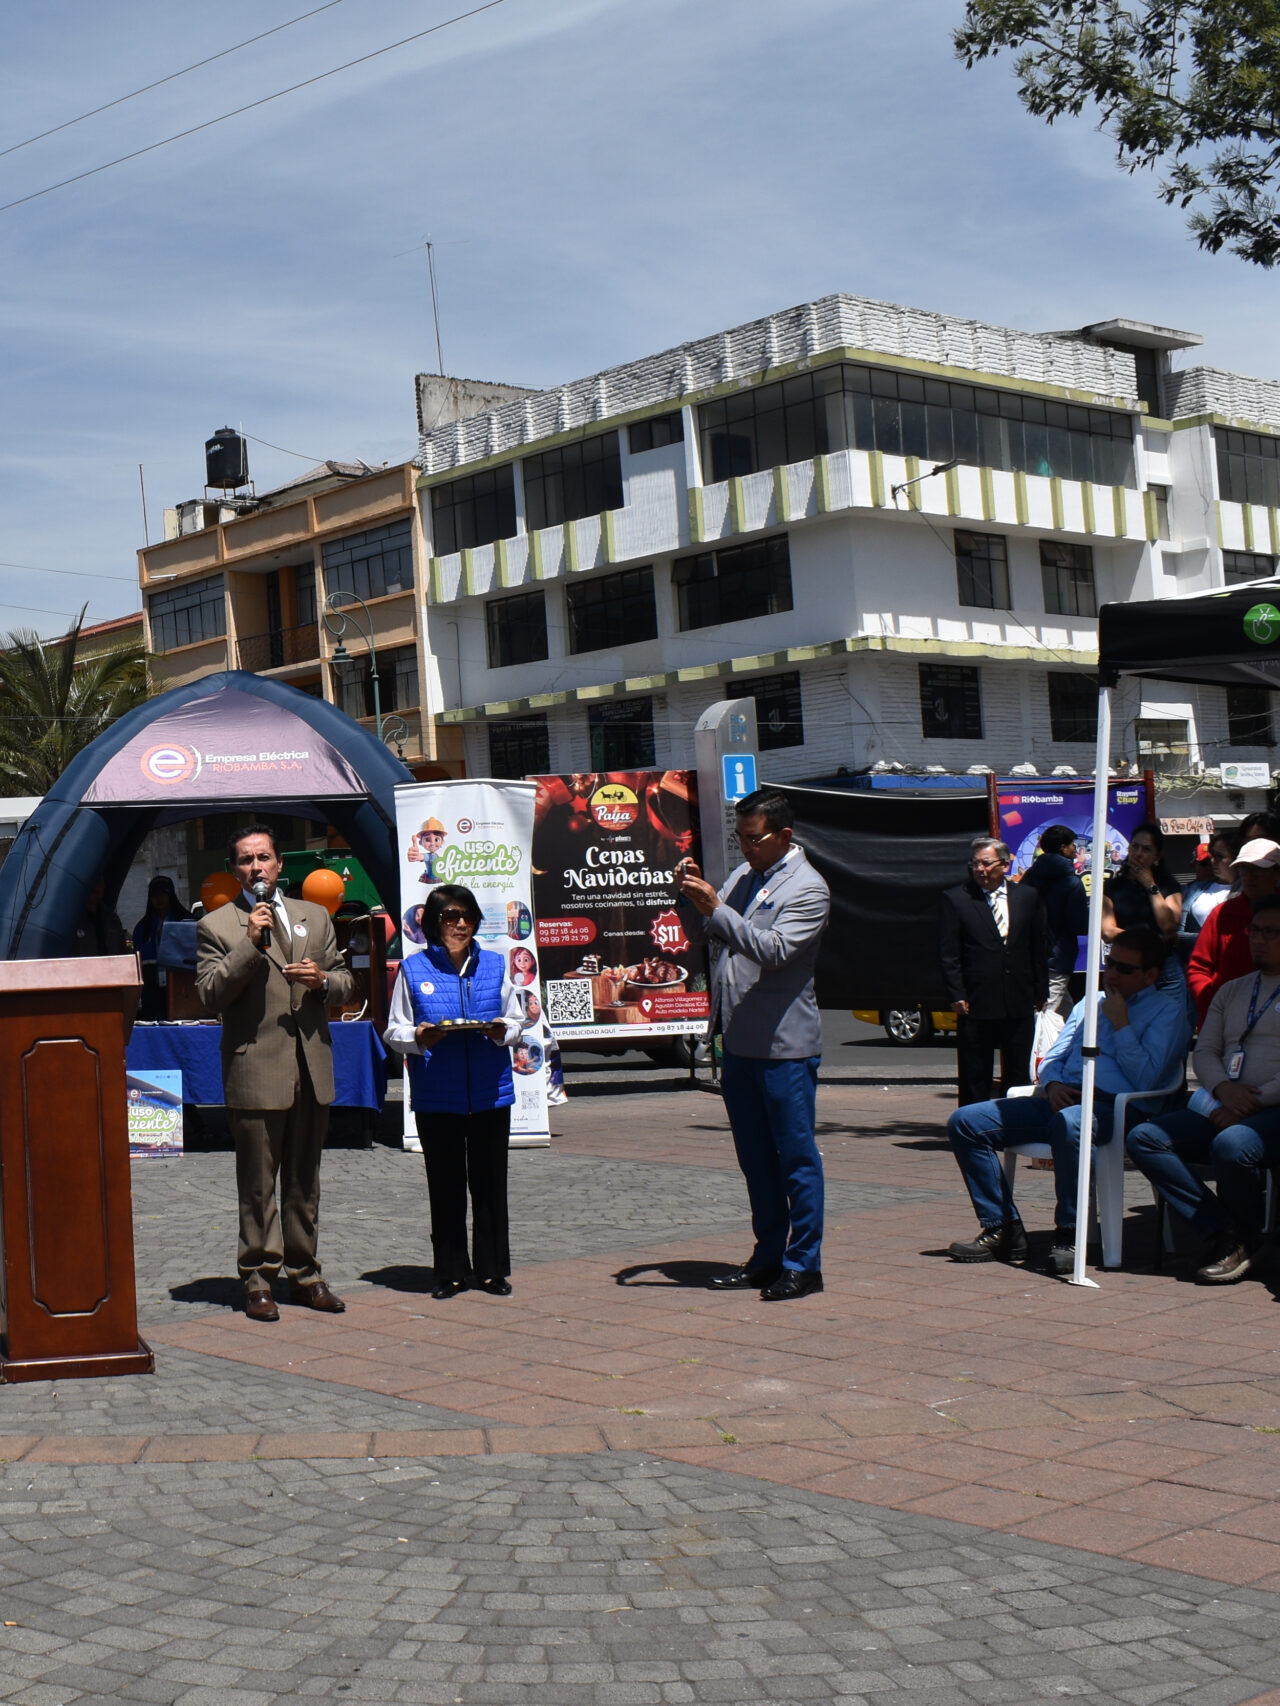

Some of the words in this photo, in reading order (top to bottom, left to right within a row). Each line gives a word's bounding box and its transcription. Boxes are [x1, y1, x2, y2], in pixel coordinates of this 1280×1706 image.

[205, 753, 257, 765] Empresa
[259, 751, 309, 762] Eléctrica
[212, 762, 278, 772] RIOBAMBA
[280, 762, 303, 770] S.A.
[465, 840, 495, 854] uso
[585, 846, 645, 867] Cenas
[435, 849, 517, 881] eficiente
[563, 866, 674, 889] Navideñas
[572, 893, 586, 901] Ten
[602, 891, 631, 900] navidad
[632, 891, 644, 899] sin
[595, 900, 635, 908] cocinamos,
